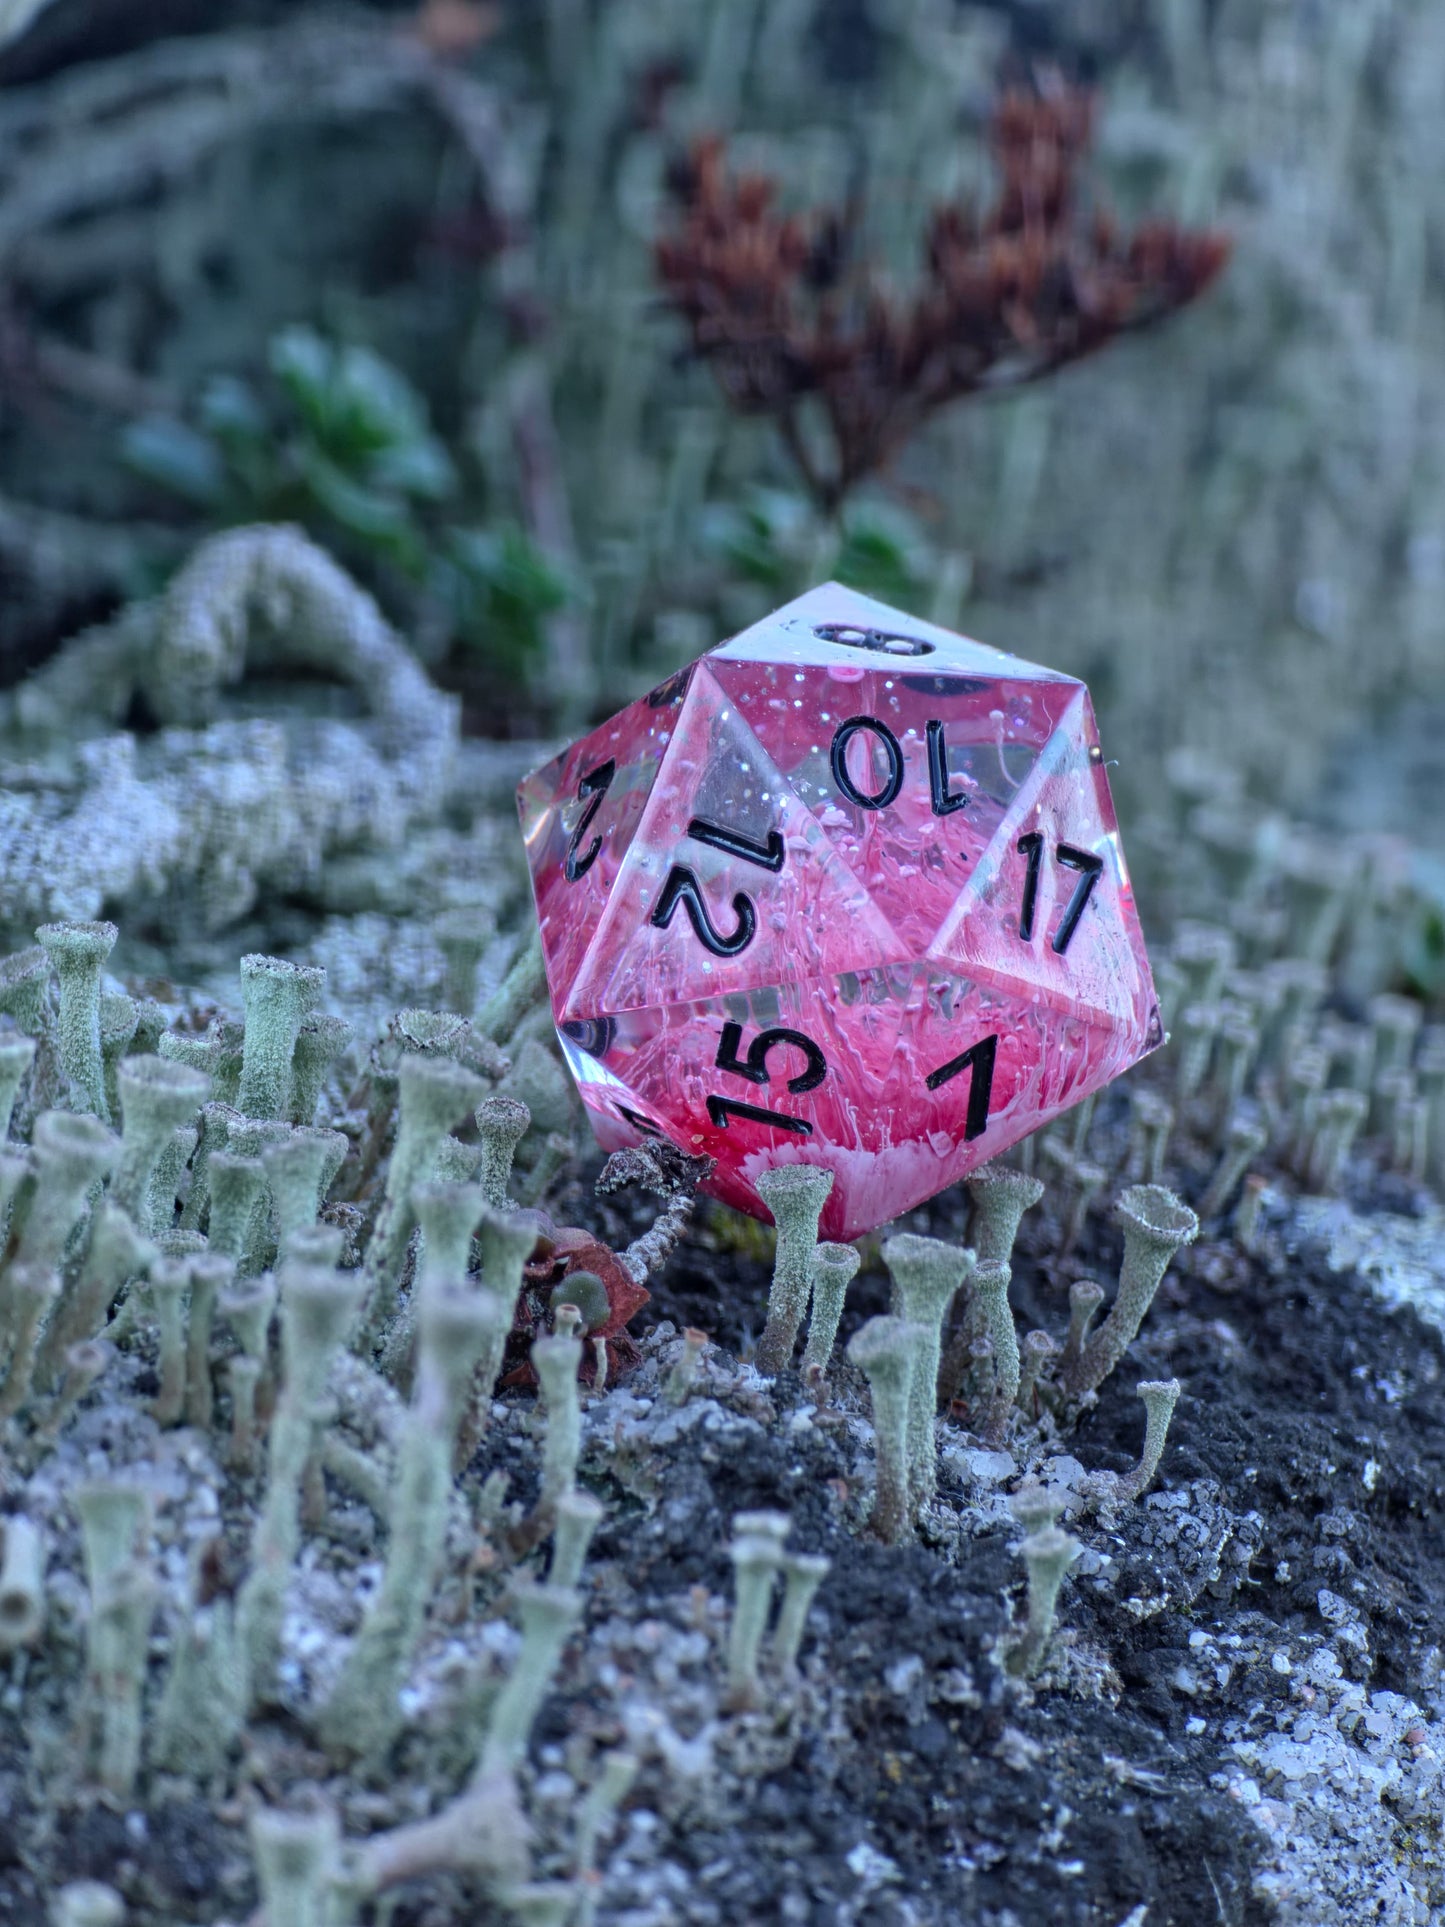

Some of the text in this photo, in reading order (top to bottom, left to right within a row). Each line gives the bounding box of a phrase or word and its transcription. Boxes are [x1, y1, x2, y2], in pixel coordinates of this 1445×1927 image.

[830, 715, 970, 817] 10
[650, 818, 785, 957] 12
[1016, 832, 1103, 954] 17
[705, 1021, 827, 1136] 15
[925, 1034, 998, 1141] 7
